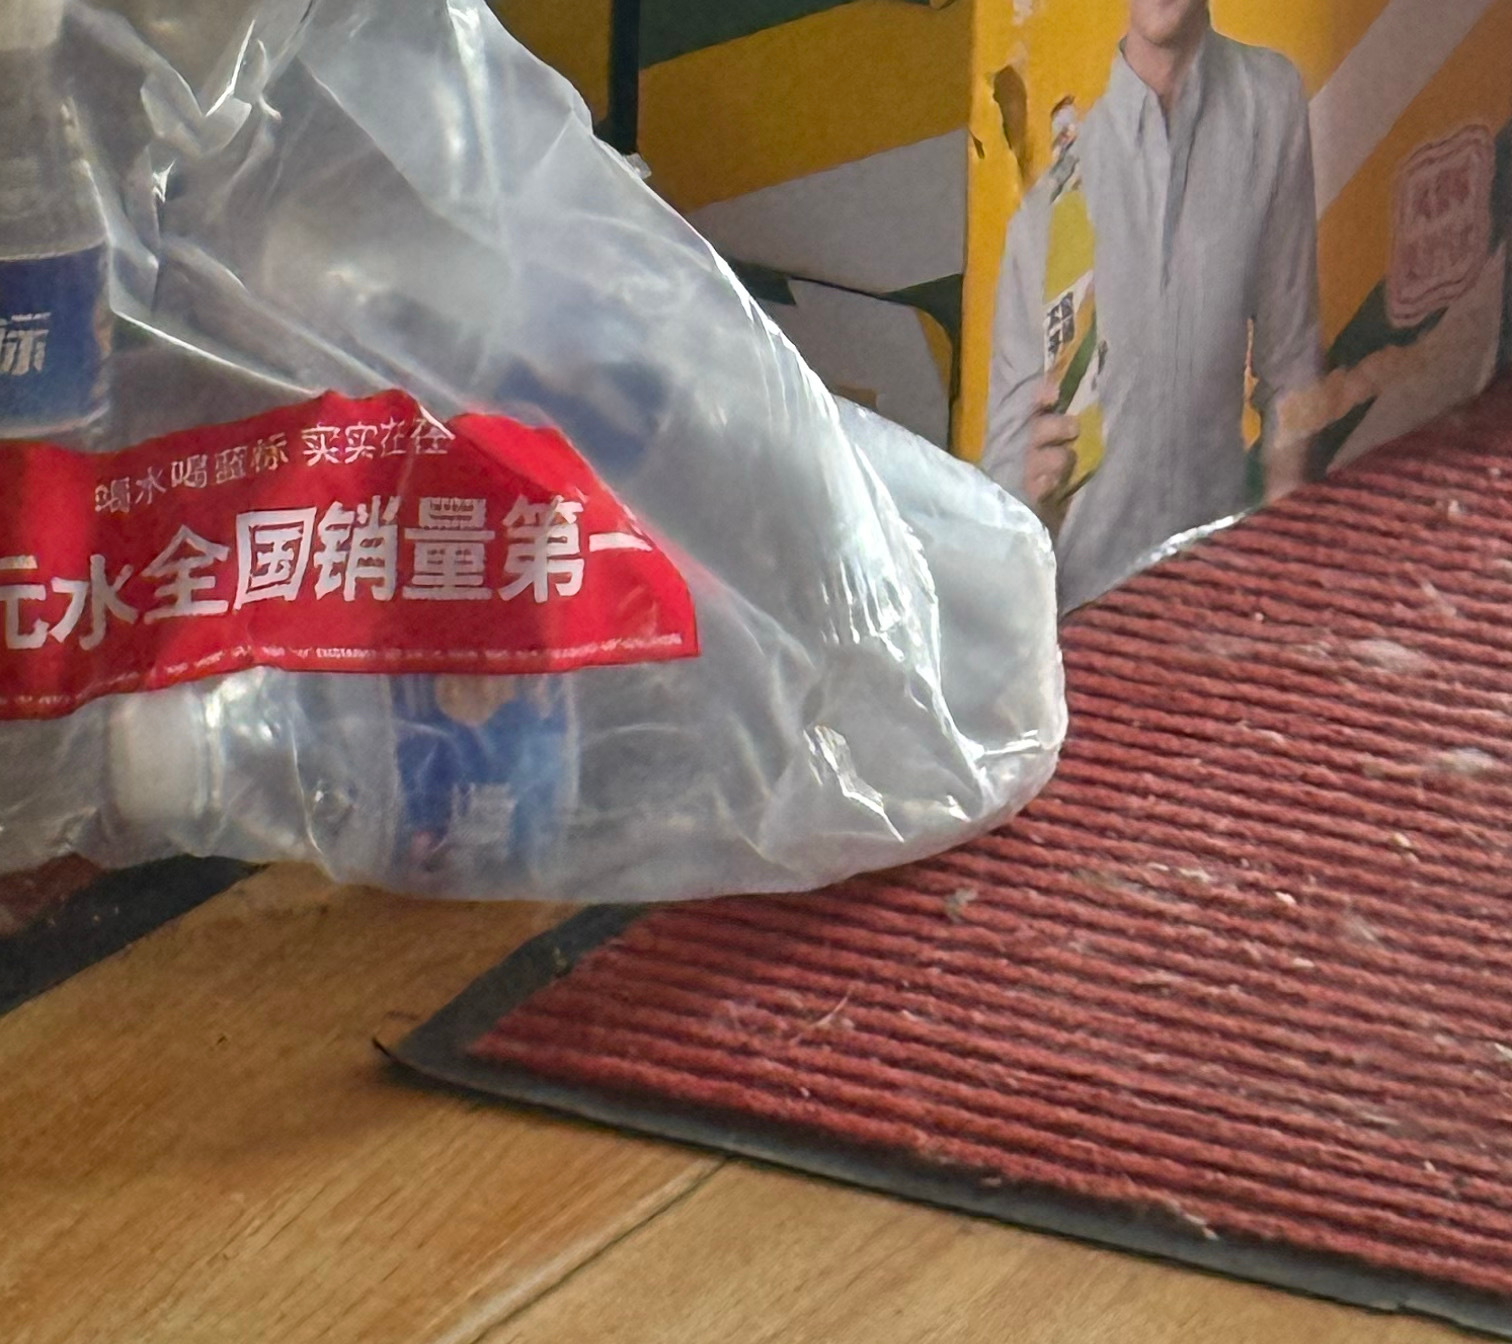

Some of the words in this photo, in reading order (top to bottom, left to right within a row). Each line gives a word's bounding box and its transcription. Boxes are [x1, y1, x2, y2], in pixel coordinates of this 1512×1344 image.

[94, 432, 288, 513] 喝水喝蓝标
